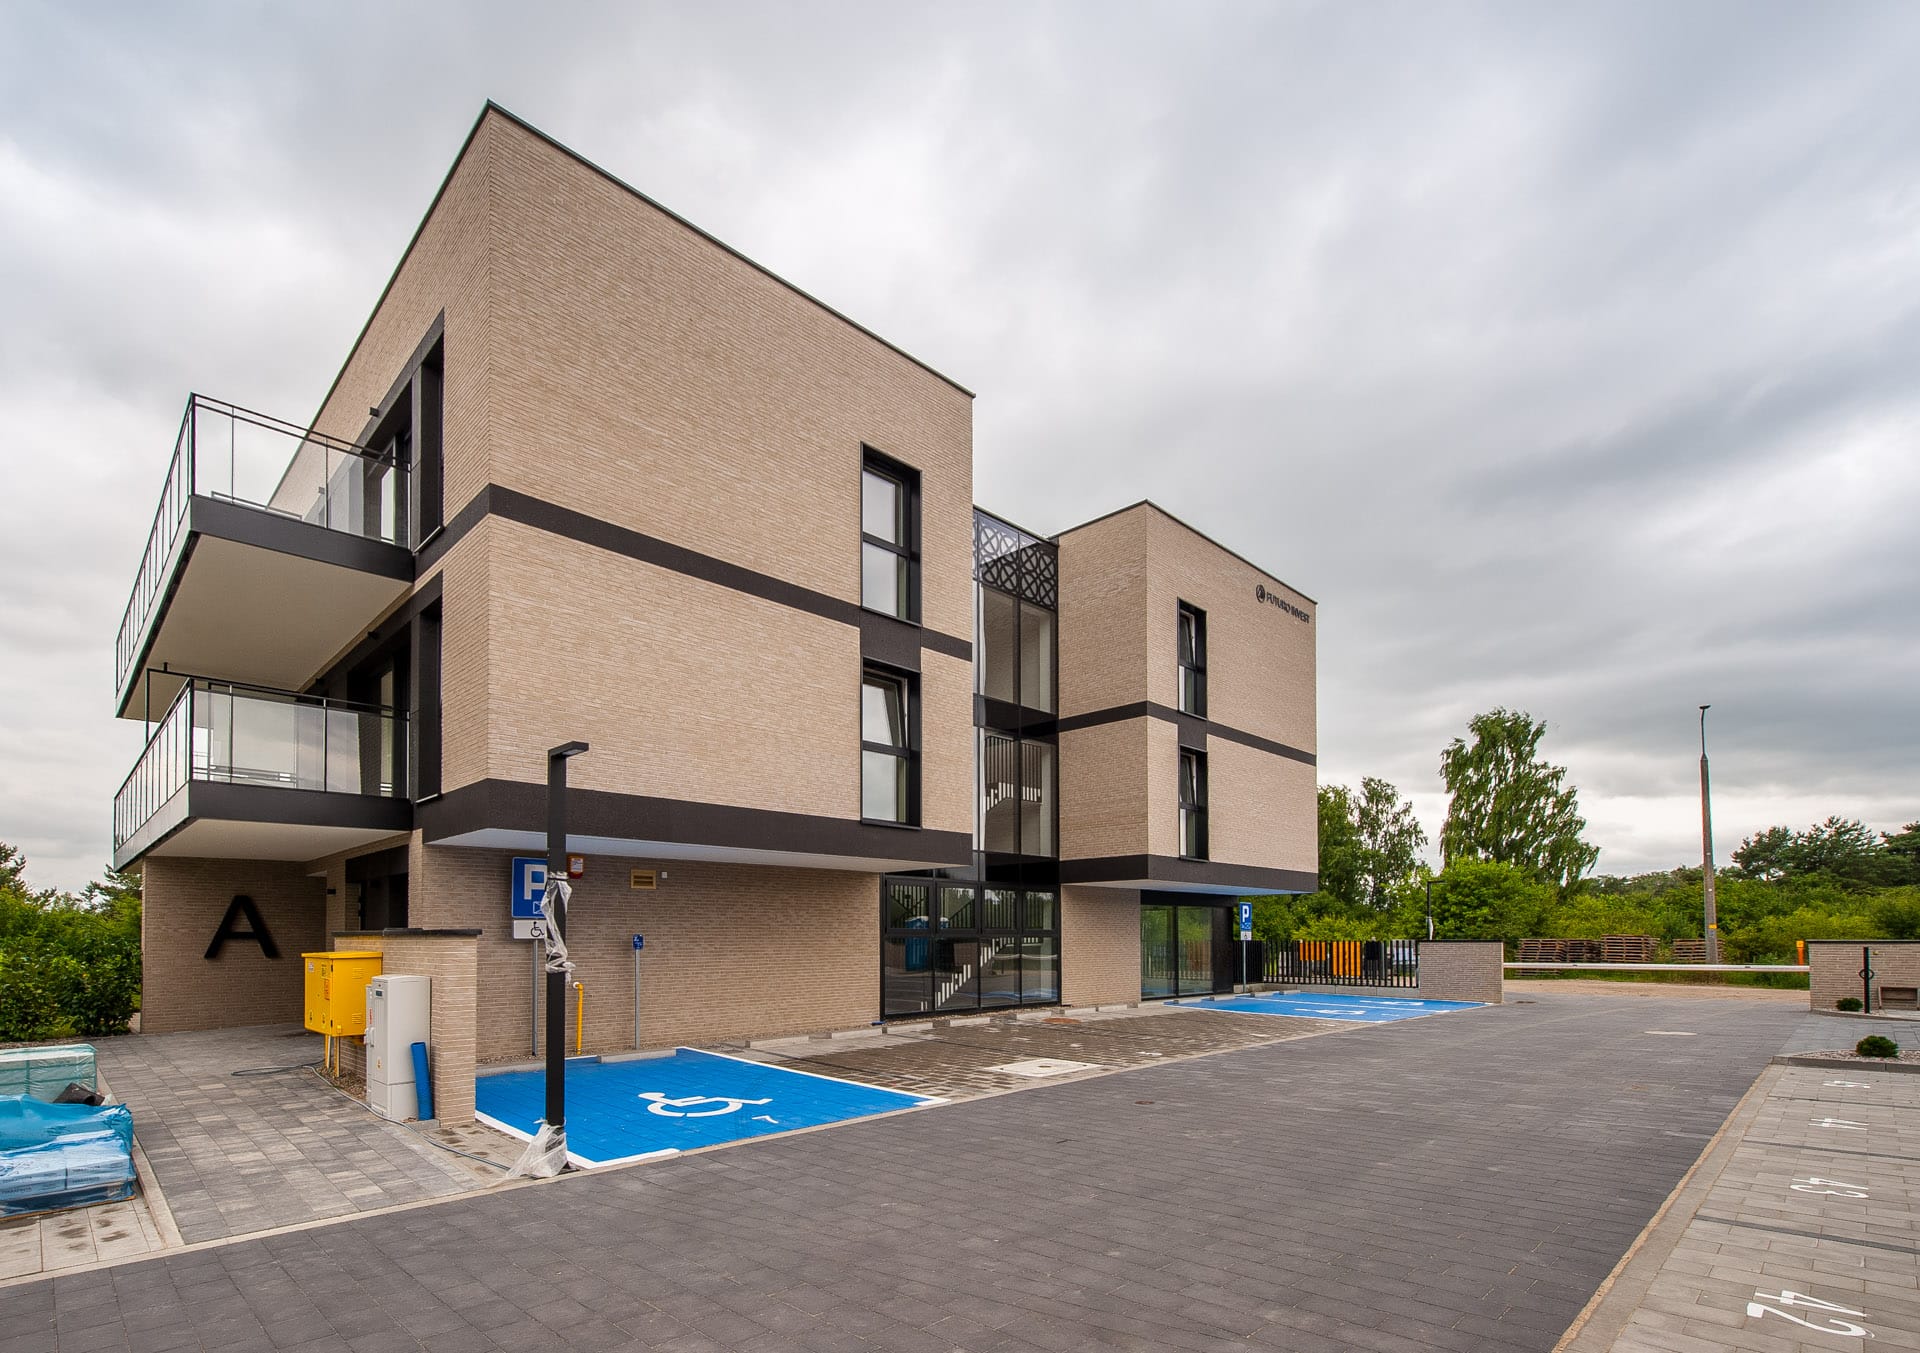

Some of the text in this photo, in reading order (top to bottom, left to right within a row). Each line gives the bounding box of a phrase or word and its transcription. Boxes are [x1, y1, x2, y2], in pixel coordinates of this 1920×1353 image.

[524, 864, 548, 900] P
[204, 895, 281, 959] A
[1242, 905, 1249, 923] P
[1790, 1177, 1869, 1199] 43
[1746, 1289, 1876, 1338] 42
